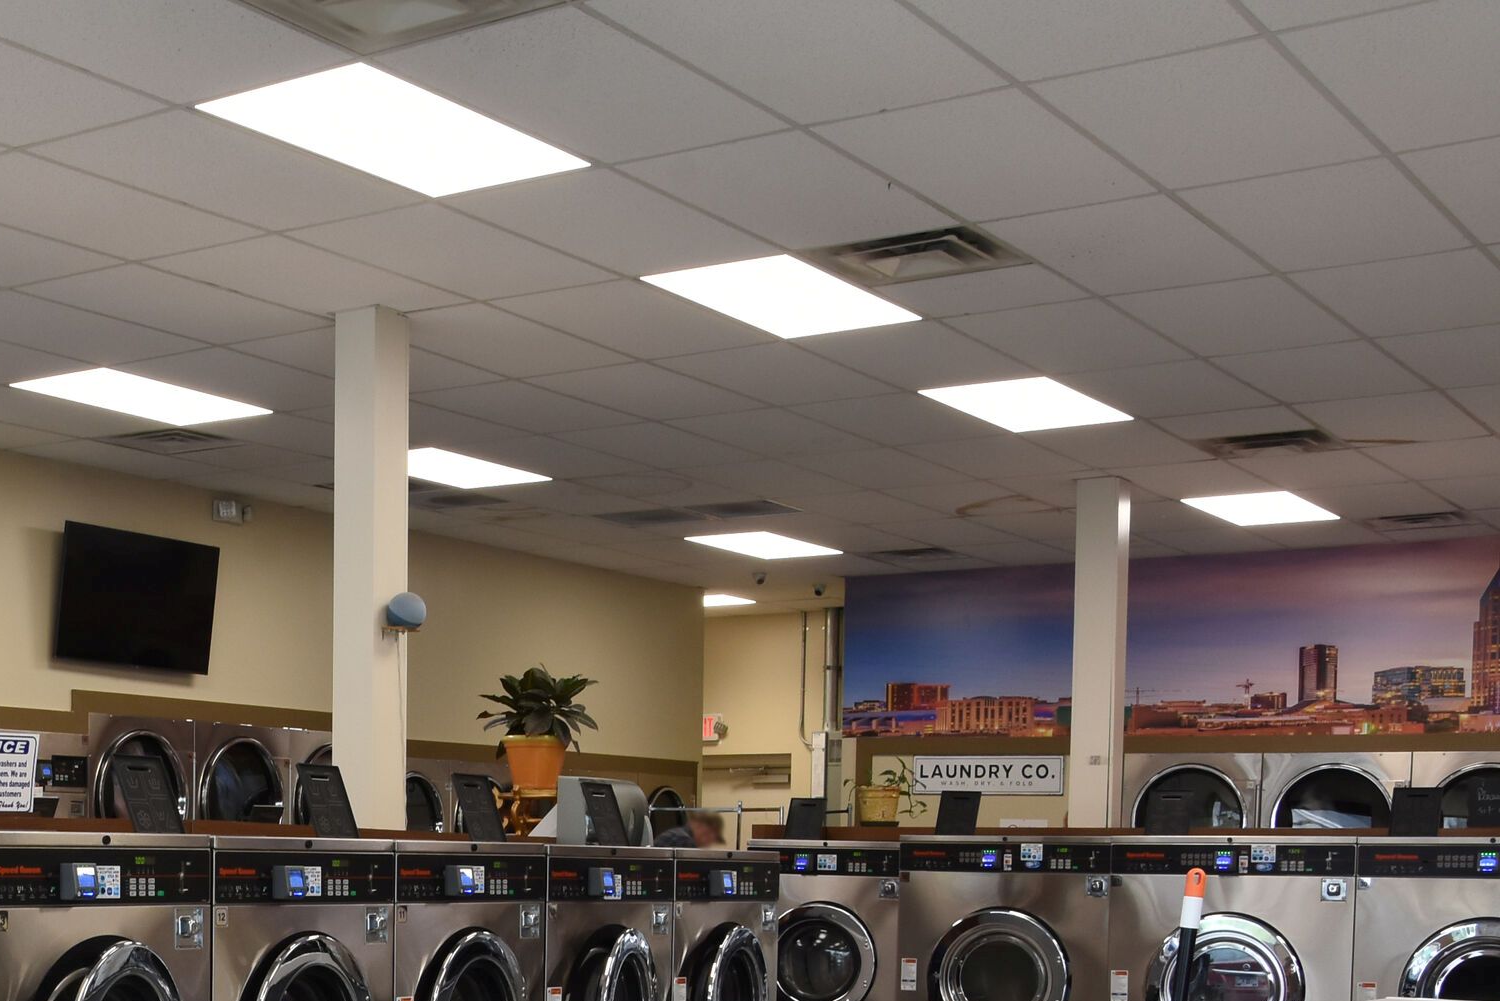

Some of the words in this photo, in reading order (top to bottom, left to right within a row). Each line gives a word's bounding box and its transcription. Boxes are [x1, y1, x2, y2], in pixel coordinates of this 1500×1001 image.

[920, 764, 1014, 779] LAUNDRY
[1021, 764, 1055, 779] CO.
[9, 780, 30, 789] damaged
[16, 801, 28, 810] You!
[218, 912, 226, 921] 12
